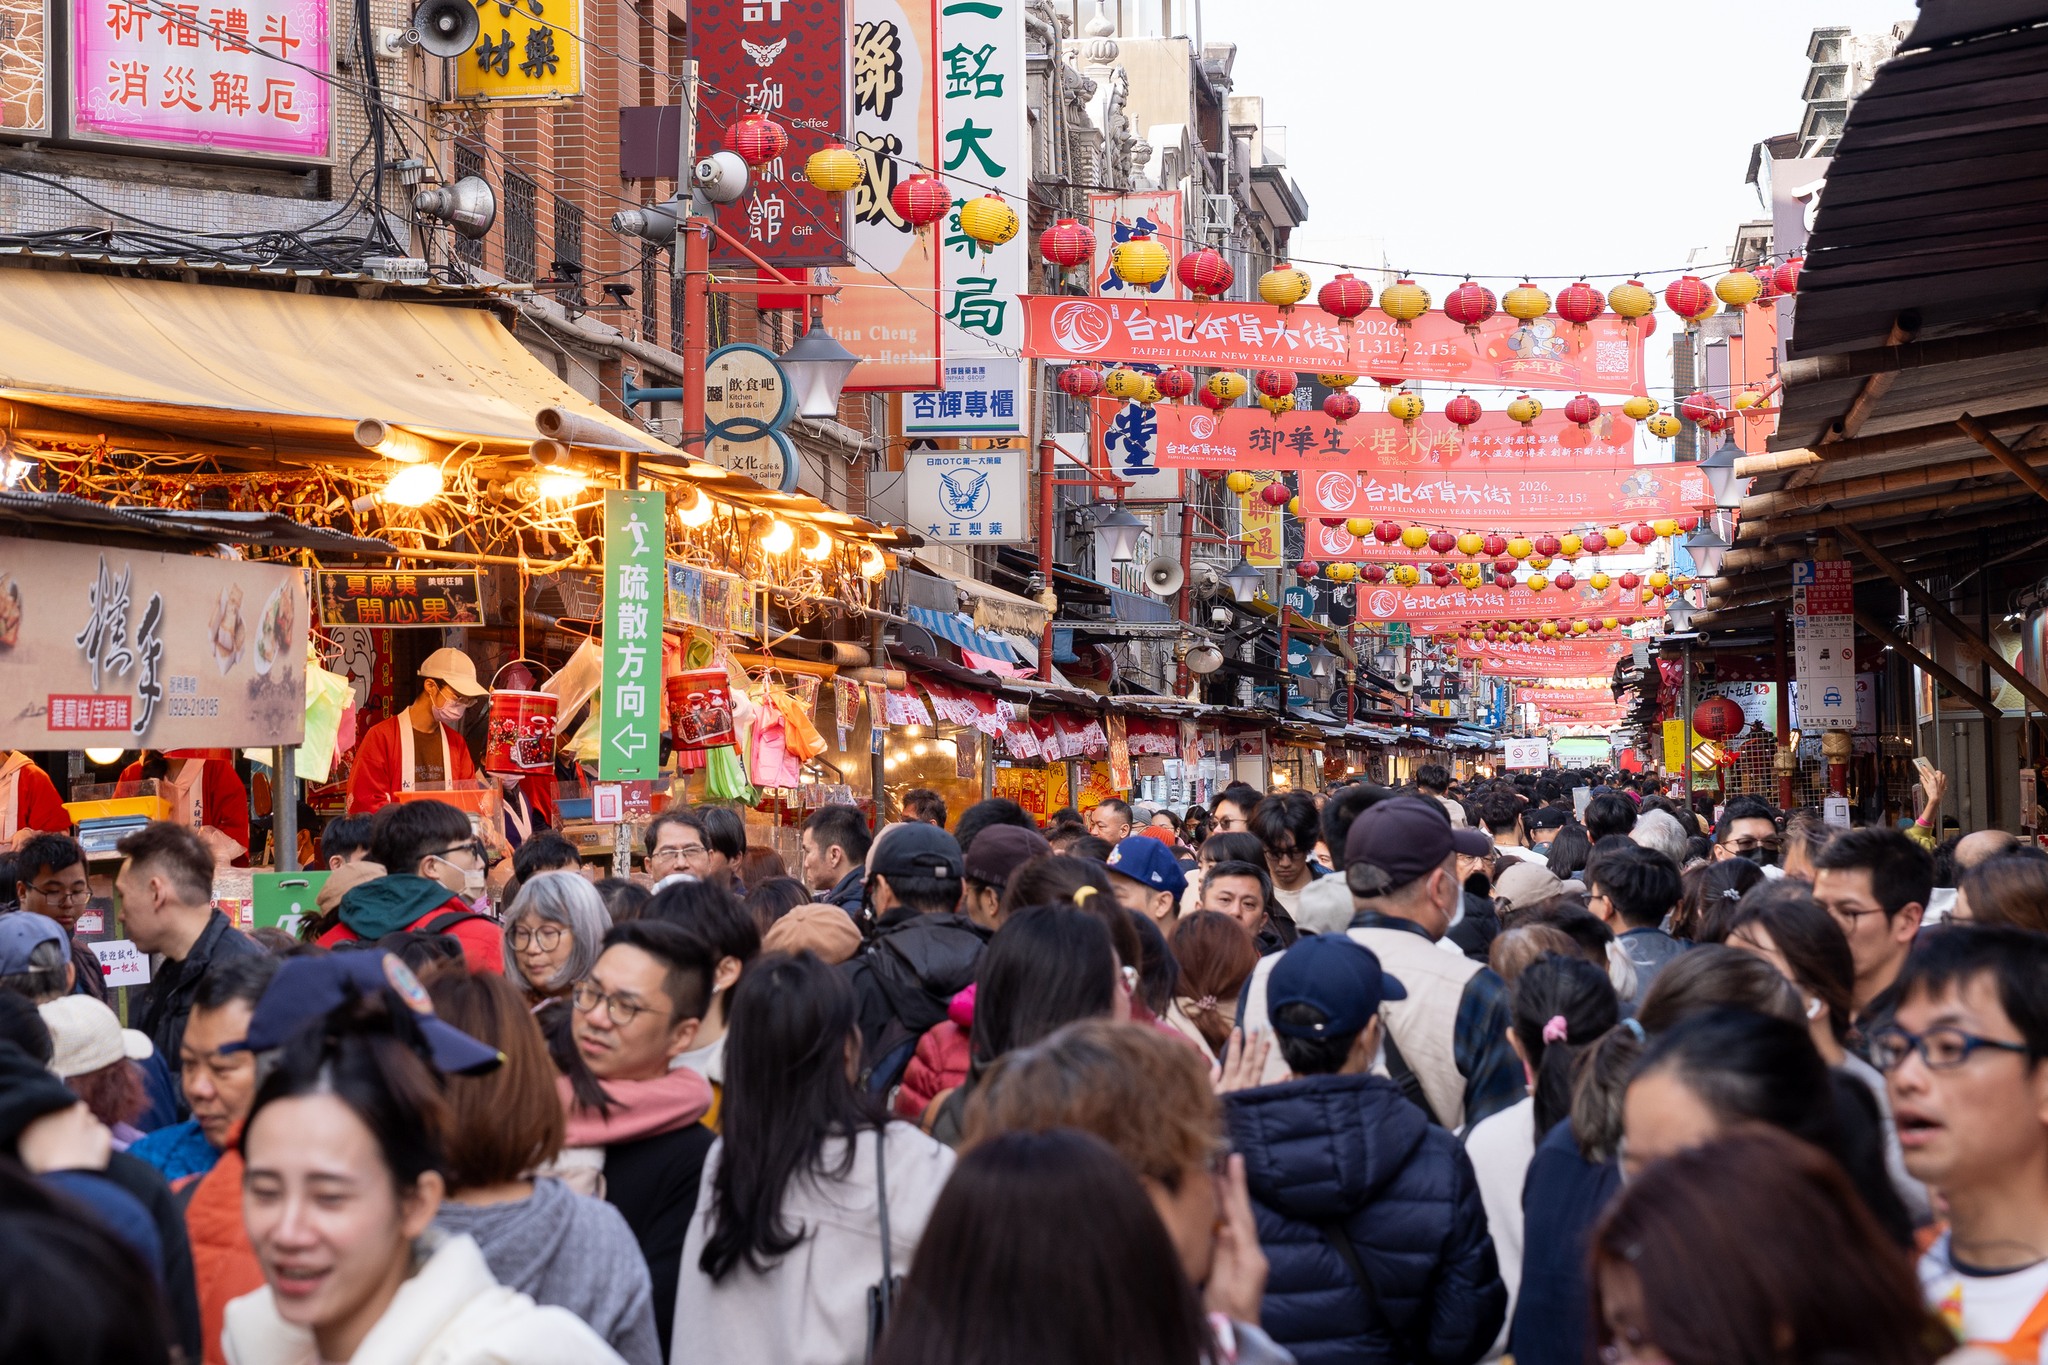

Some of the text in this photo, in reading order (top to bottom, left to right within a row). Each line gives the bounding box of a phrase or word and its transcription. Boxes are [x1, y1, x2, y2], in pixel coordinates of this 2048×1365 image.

[107, 0, 301, 58] 祈福禮斗
[109, 61, 301, 122] 消災解厄
[791, 117, 829, 129] Coffee
[791, 224, 813, 237] Gift
[828, 325, 917, 344] Lian Cheng
[1122, 306, 1346, 355] 台北年貨大街
[1357, 338, 1392, 355] 1.31
[1413, 341, 1449, 356] 2.15
[880, 350, 934, 366] Herbal
[1130, 346, 1171, 356] TAIPEI
[1174, 348, 1217, 359] LUNAR
[1221, 351, 1249, 361] NEW
[1252, 353, 1284, 364] YEAR
[1288, 356, 1345, 367] FESTIVAL
[913, 390, 1014, 419] 杏輝專櫃
[1166, 441, 1237, 457] 台北年貨大街
[1249, 425, 1350, 457] 御華生
[731, 455, 758, 470] 文化
[759, 471, 782, 479] Gallery
[1363, 478, 1512, 505] 台北年貨大街
[1518, 480, 1552, 492] 2026.
[1519, 493, 1543, 504] 1.31
[1557, 493, 1582, 503] 2.15
[1369, 505, 1396, 513] TAIPEI
[1398, 506, 1427, 514] LUNAR
[1429, 507, 1448, 515] NEW
[1449, 508, 1471, 516] YEAR
[1473, 508, 1512, 516] FESTIVAL
[346, 575, 418, 597] 夏威夷
[1402, 592, 1505, 610] 台北年貨大街
[356, 598, 451, 624] 開心果
[615, 563, 649, 718] 疏散方向
[1840, 717, 1853, 726] 110
